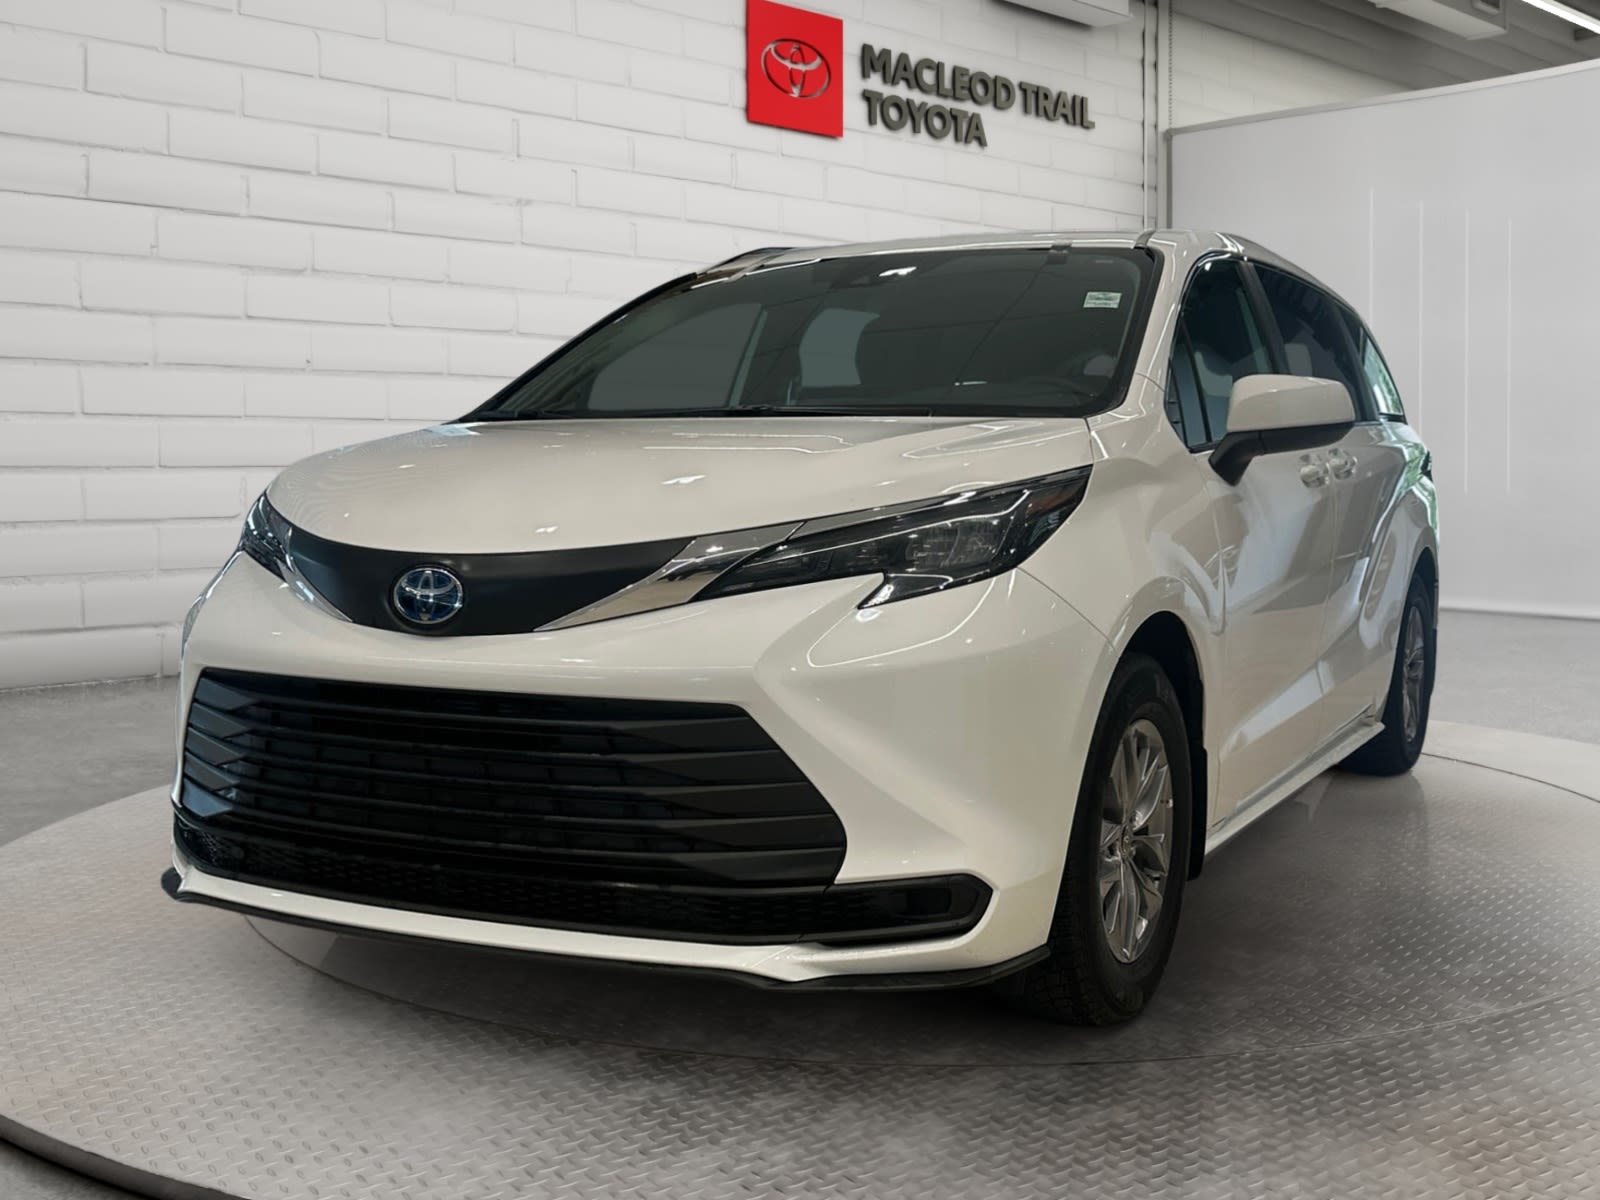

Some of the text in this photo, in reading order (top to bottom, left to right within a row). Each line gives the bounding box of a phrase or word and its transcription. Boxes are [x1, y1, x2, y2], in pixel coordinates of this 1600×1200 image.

[861, 44, 1095, 129] MACLEOD TRAIL
[862, 89, 987, 147] TOYOTA
